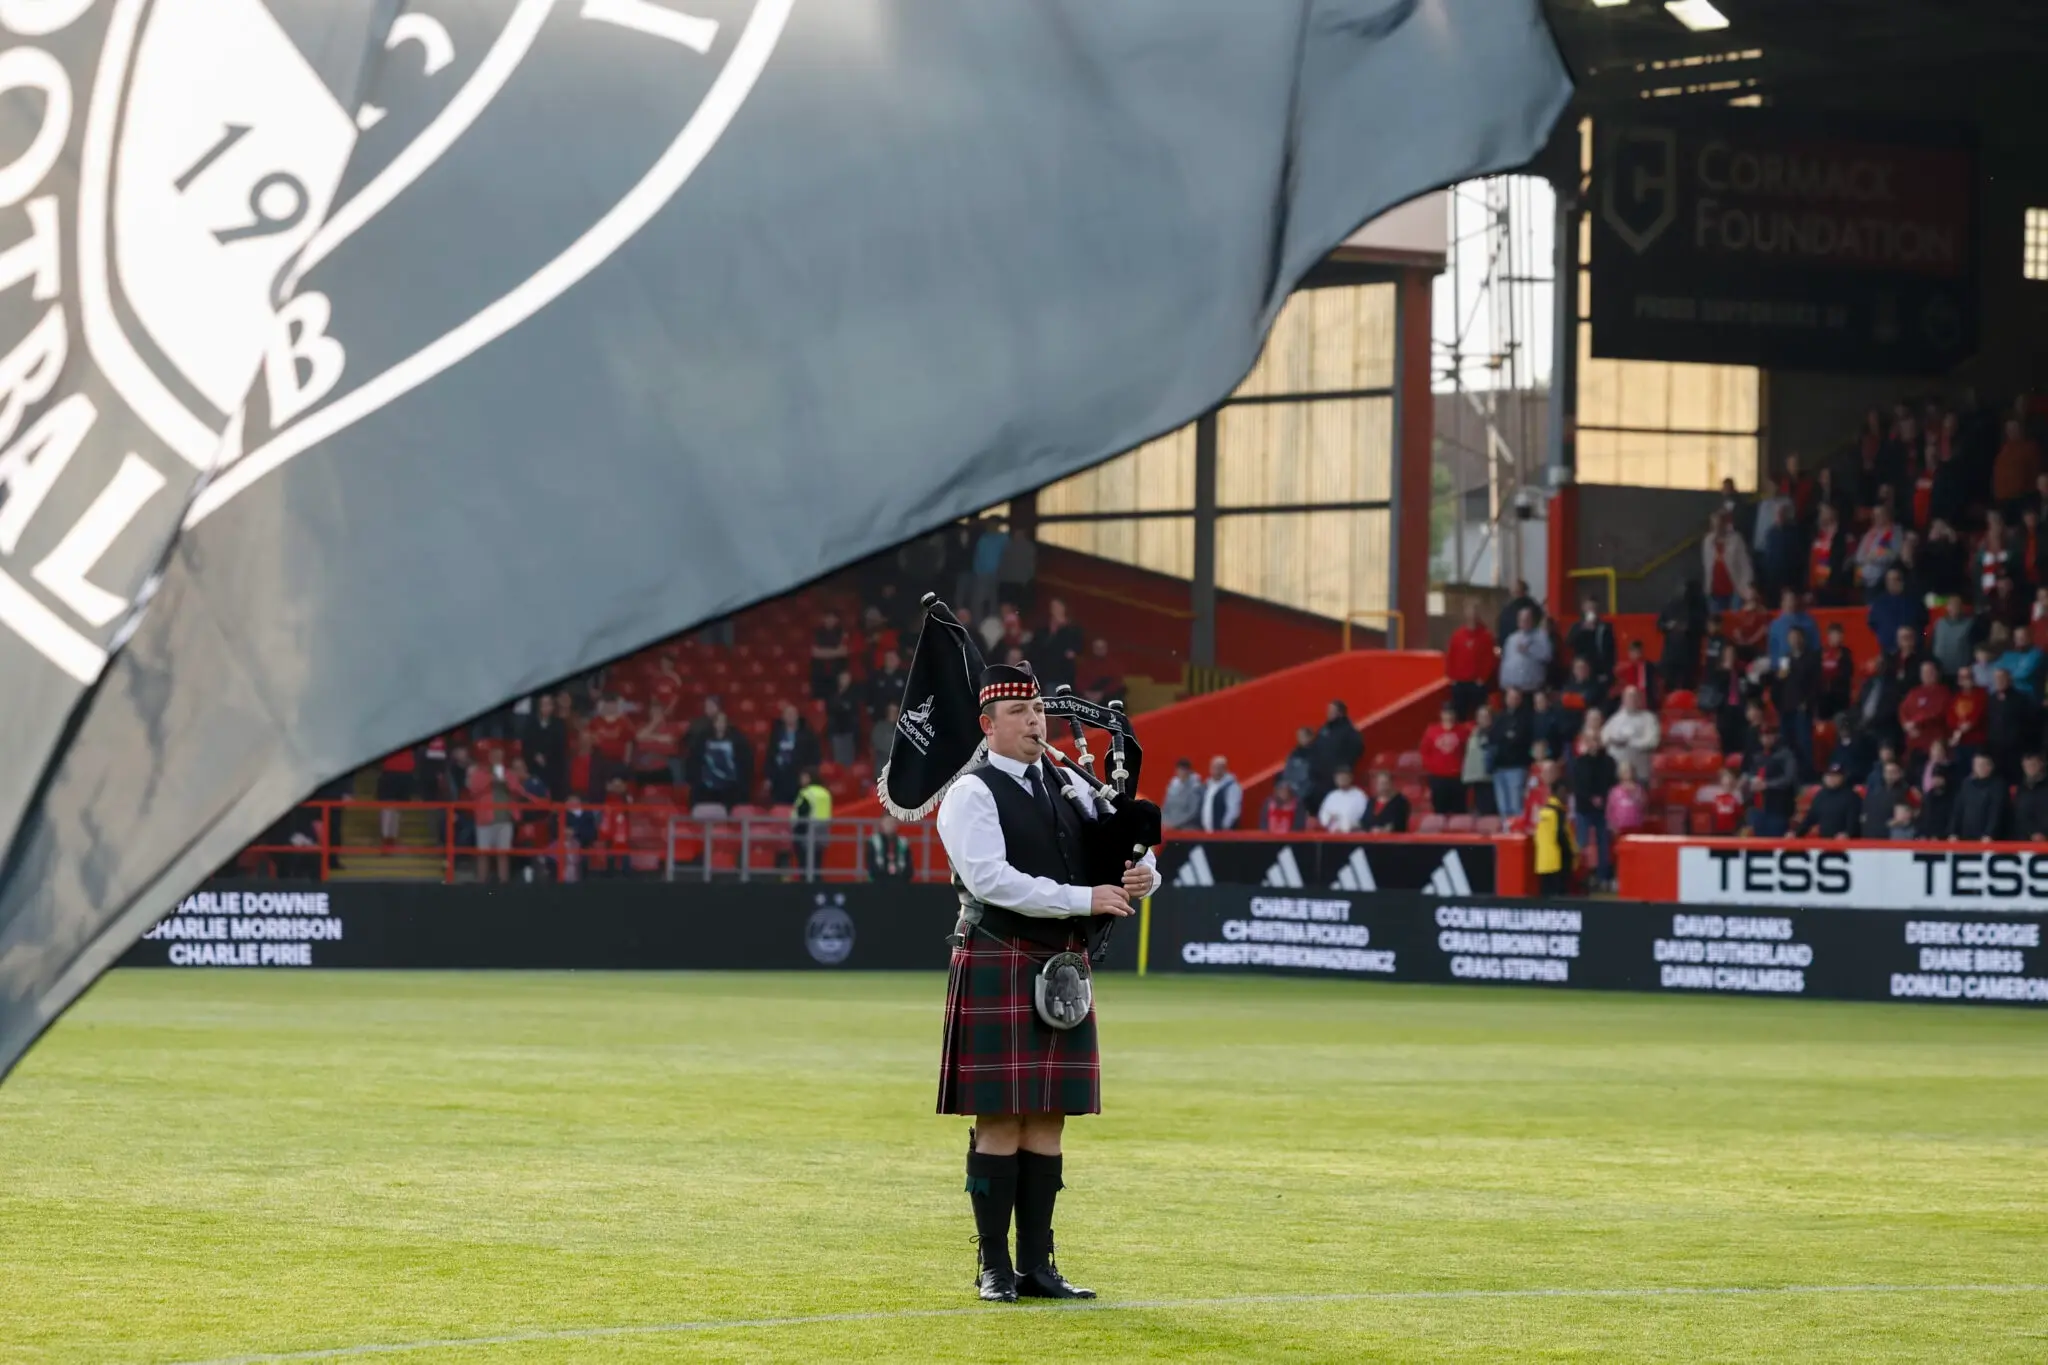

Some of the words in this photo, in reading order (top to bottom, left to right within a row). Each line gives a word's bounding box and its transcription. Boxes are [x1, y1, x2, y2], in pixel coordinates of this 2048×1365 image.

[1695, 198, 1954, 262] FOUNDATION
[1060, 700, 1100, 718] BAGPIPES
[1709, 849, 1850, 894] TESS
[177, 892, 241, 914] ARLIE
[242, 893, 330, 915] DOWNIE
[230, 918, 343, 940] MORRISON
[1435, 906, 1486, 929] COLIN
[1487, 908, 1582, 933] WILLIAMSON
[1673, 913, 1725, 938] DAVID
[1725, 916, 1794, 941] SHANKS
[1905, 920, 1961, 944] DEREK
[168, 943, 259, 965] CHARLIE
[260, 944, 313, 965] PIRIE
[1438, 930, 1490, 953] CRAIG
[1490, 932, 1548, 956] BROWN
[1654, 938, 1705, 963] DAVID
[1706, 941, 1813, 968] SUTHERLAND
[1450, 955, 1501, 979] CRAIG
[1502, 957, 1569, 982] STEPHEN
[1919, 946, 1973, 971] DIANE
[1661, 964, 1713, 989] DAWN
[1714, 967, 1805, 993] CHALMERS
[1890, 972, 1962, 998] DONALD
